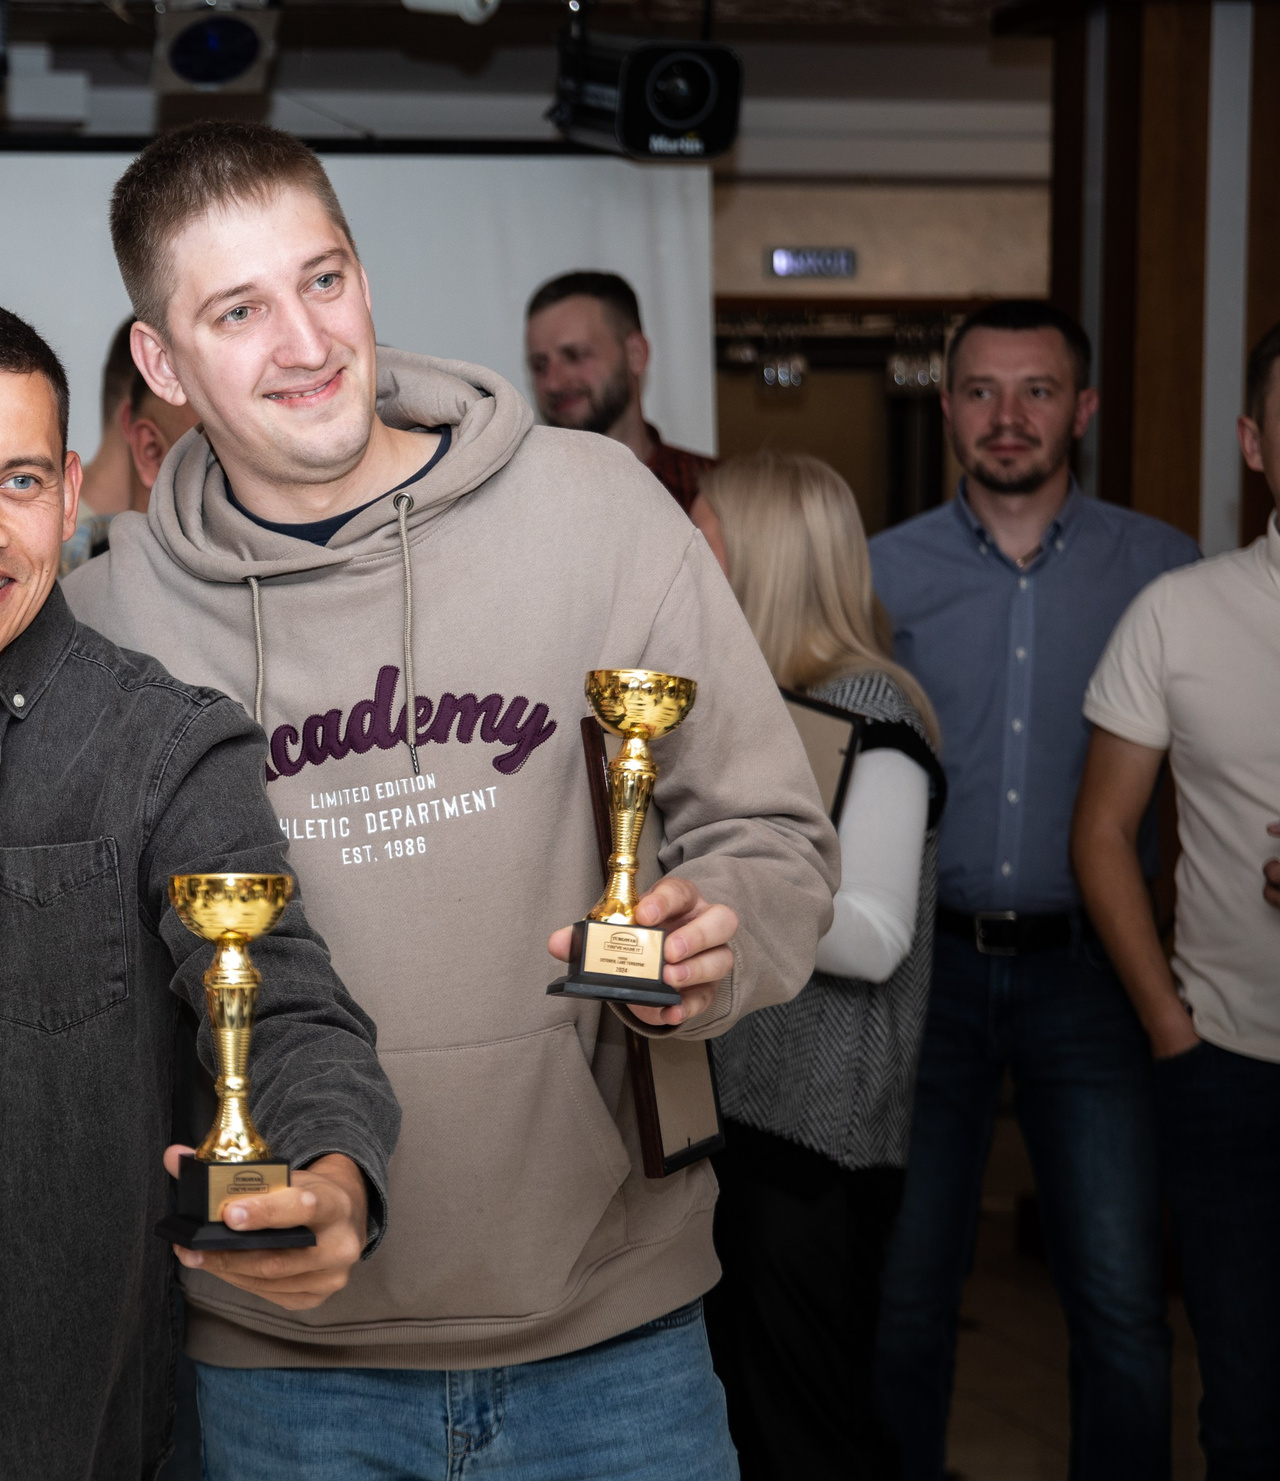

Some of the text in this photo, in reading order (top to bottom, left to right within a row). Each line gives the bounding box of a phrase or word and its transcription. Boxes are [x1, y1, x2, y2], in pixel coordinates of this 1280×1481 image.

[265, 665, 558, 782] cademy
[279, 785, 498, 840] HLETIC DEPARTMENT
[310, 772, 437, 810] LIMITED EDITION
[341, 836, 427, 865] EST. 1986
